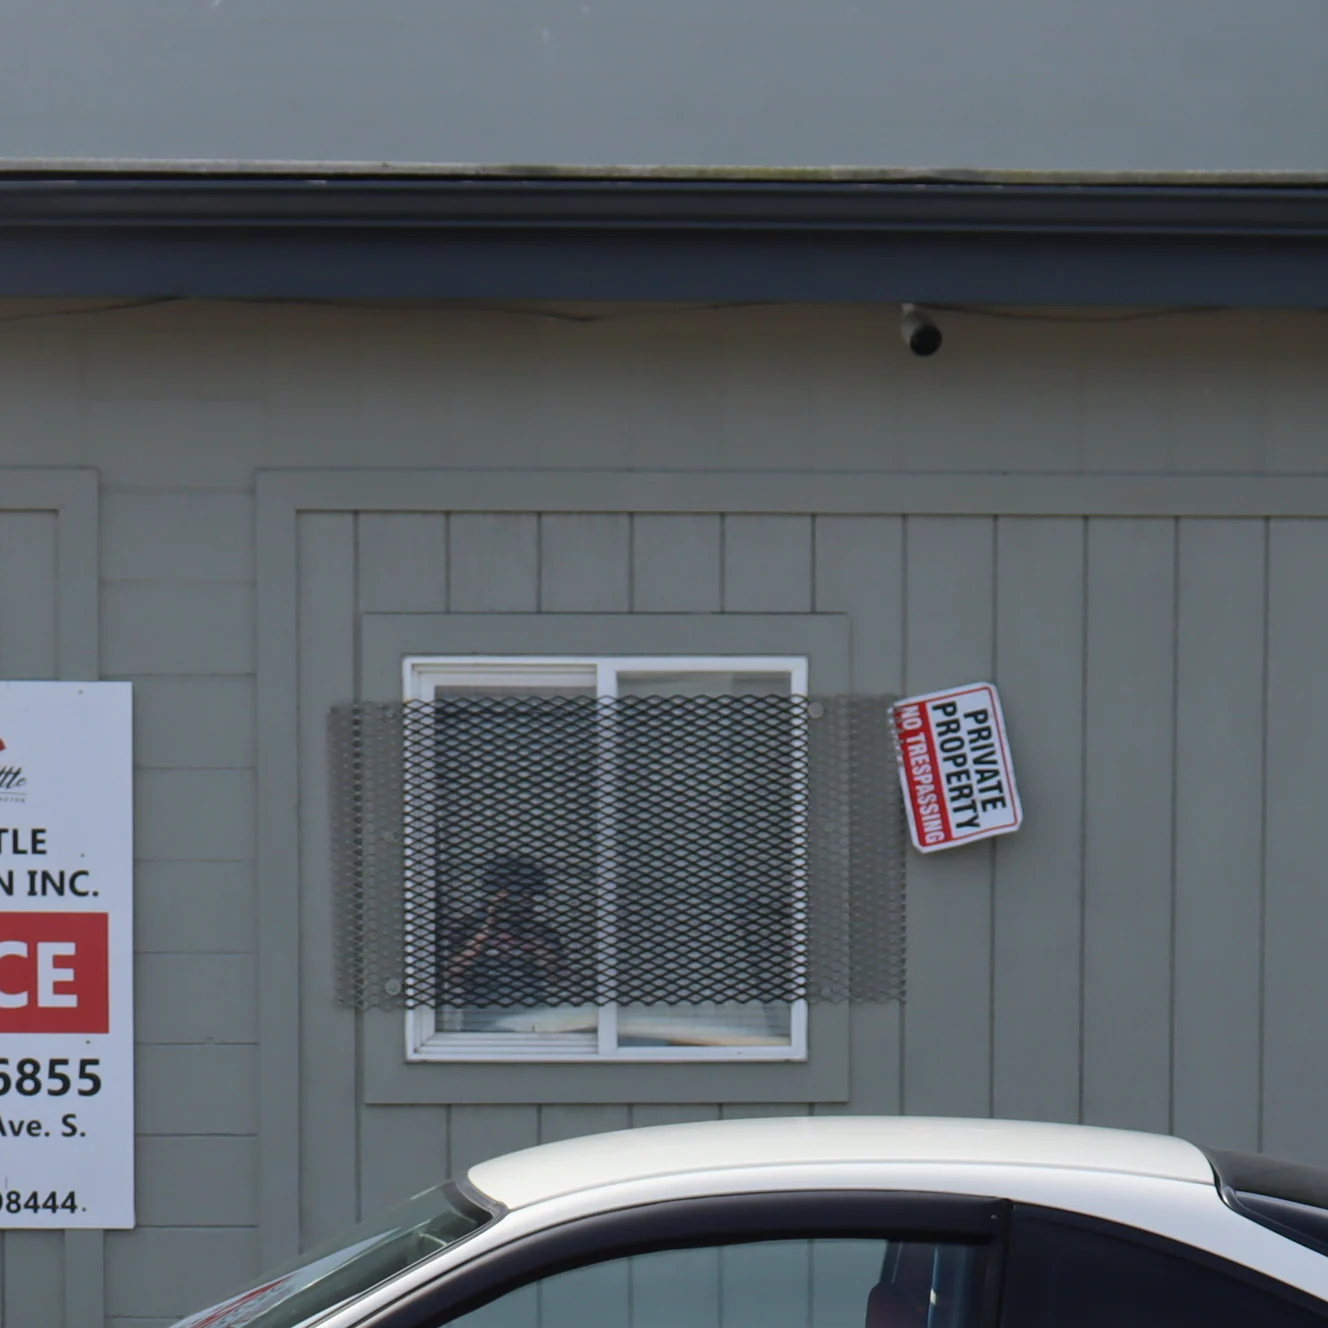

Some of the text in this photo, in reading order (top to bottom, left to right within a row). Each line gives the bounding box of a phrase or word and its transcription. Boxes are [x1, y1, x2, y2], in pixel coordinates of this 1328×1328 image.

[901, 705, 945, 844] NO TRESPASSING
[932, 701, 981, 829] PROPERTY
[963, 708, 1007, 813] PRIVATE
[27, 870, 100, 898] INC.
[61, 1113, 86, 1138] S.
